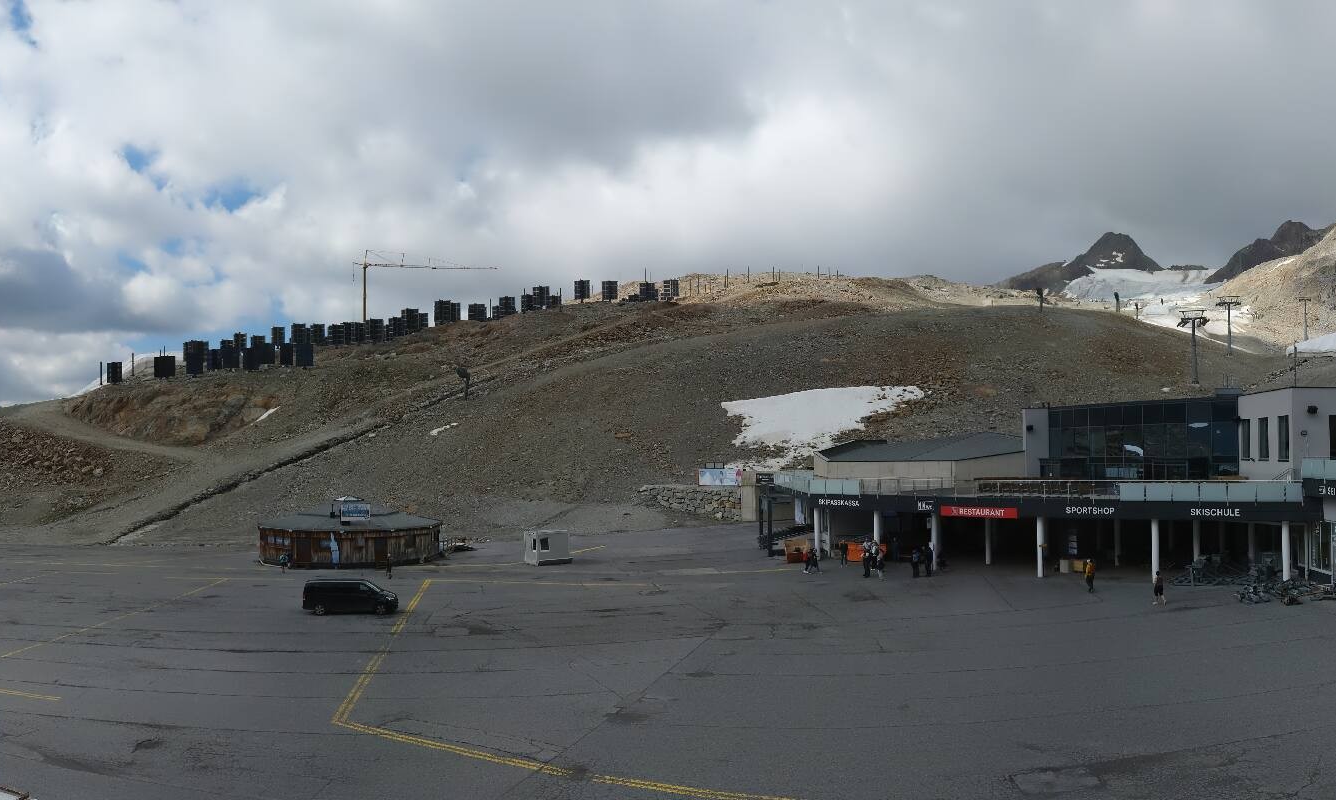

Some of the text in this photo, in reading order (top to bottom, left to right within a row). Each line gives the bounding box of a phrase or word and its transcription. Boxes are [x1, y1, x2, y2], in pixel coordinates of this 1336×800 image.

[959, 507, 1005, 517] RESTAURANT
[1065, 506, 1115, 516] SPORTSHOP
[1190, 508, 1241, 517] SKISCHULE
